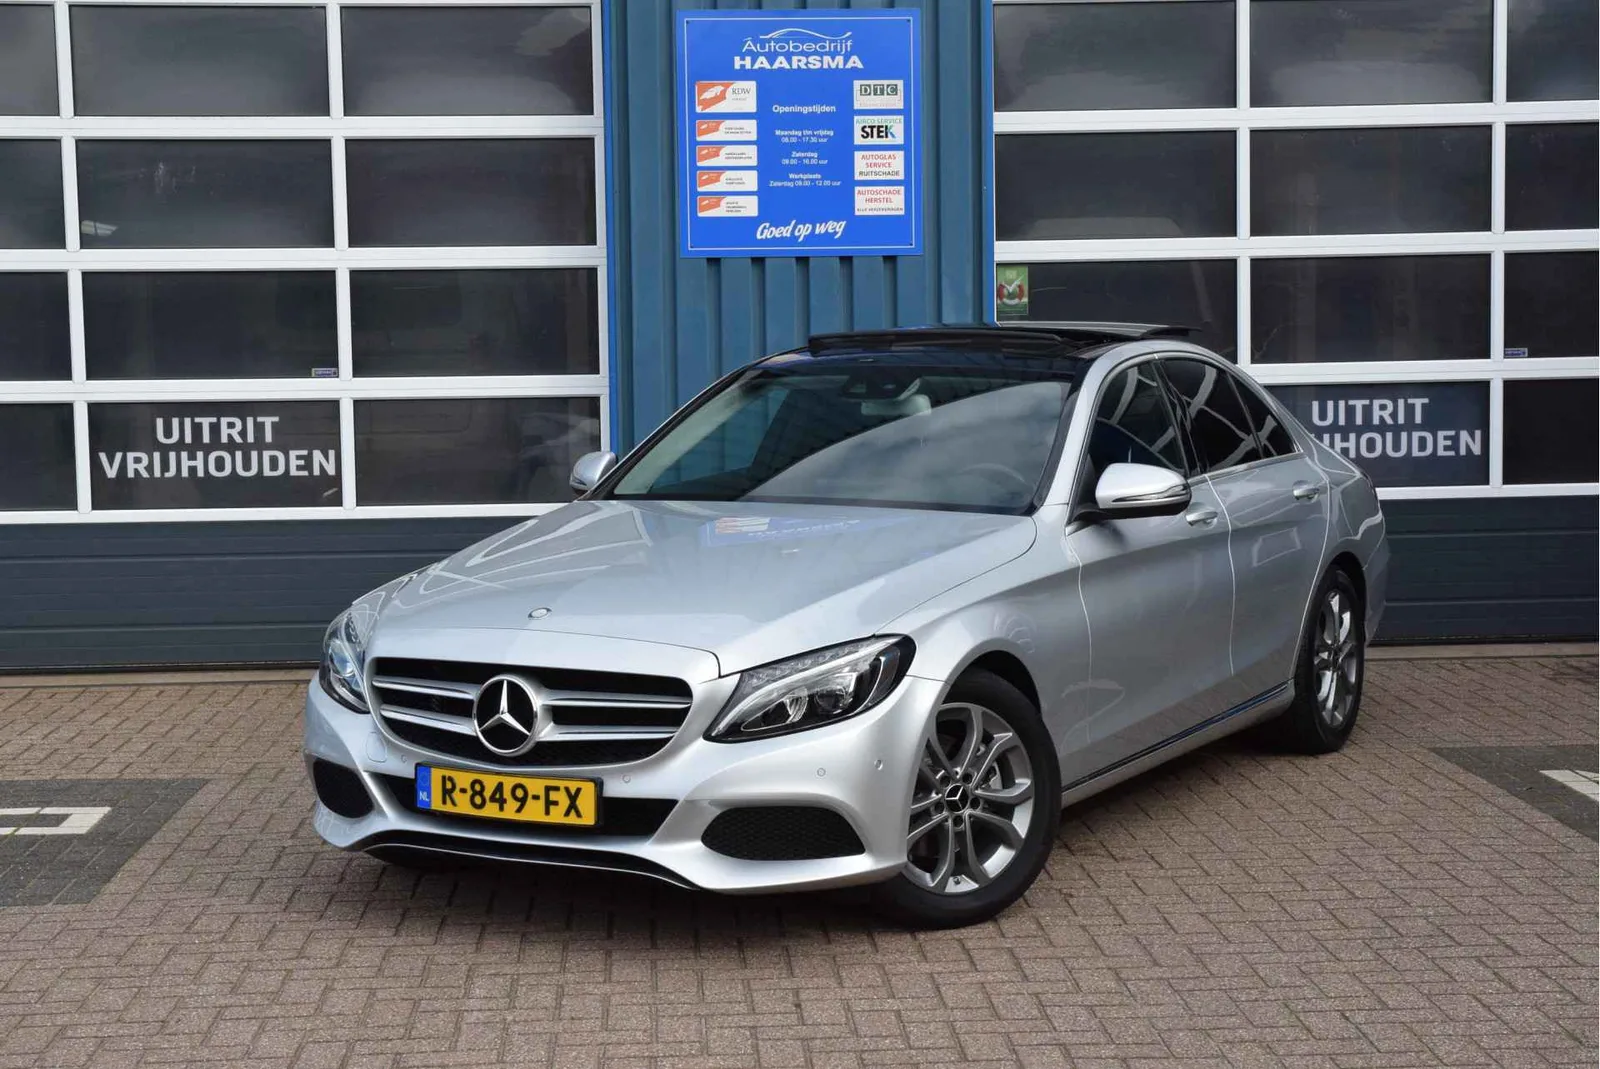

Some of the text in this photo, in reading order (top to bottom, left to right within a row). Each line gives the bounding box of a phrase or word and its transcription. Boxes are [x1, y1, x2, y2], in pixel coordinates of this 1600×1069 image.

[742, 39, 853, 55] Autobedrijf
[733, 55, 865, 70] HAARSMA
[731, 87, 751, 96] RDW
[860, 84, 898, 96] DTC
[772, 104, 836, 114] Openingstijden
[861, 125, 896, 139] STEK
[756, 219, 847, 243] Goed op weg
[1312, 398, 1430, 427] UITRIT
[156, 416, 280, 444] UITRIT
[98, 449, 336, 478] VRIJHOUDEN
[419, 792, 430, 802] NL
[441, 774, 583, 819] R-849-FX
